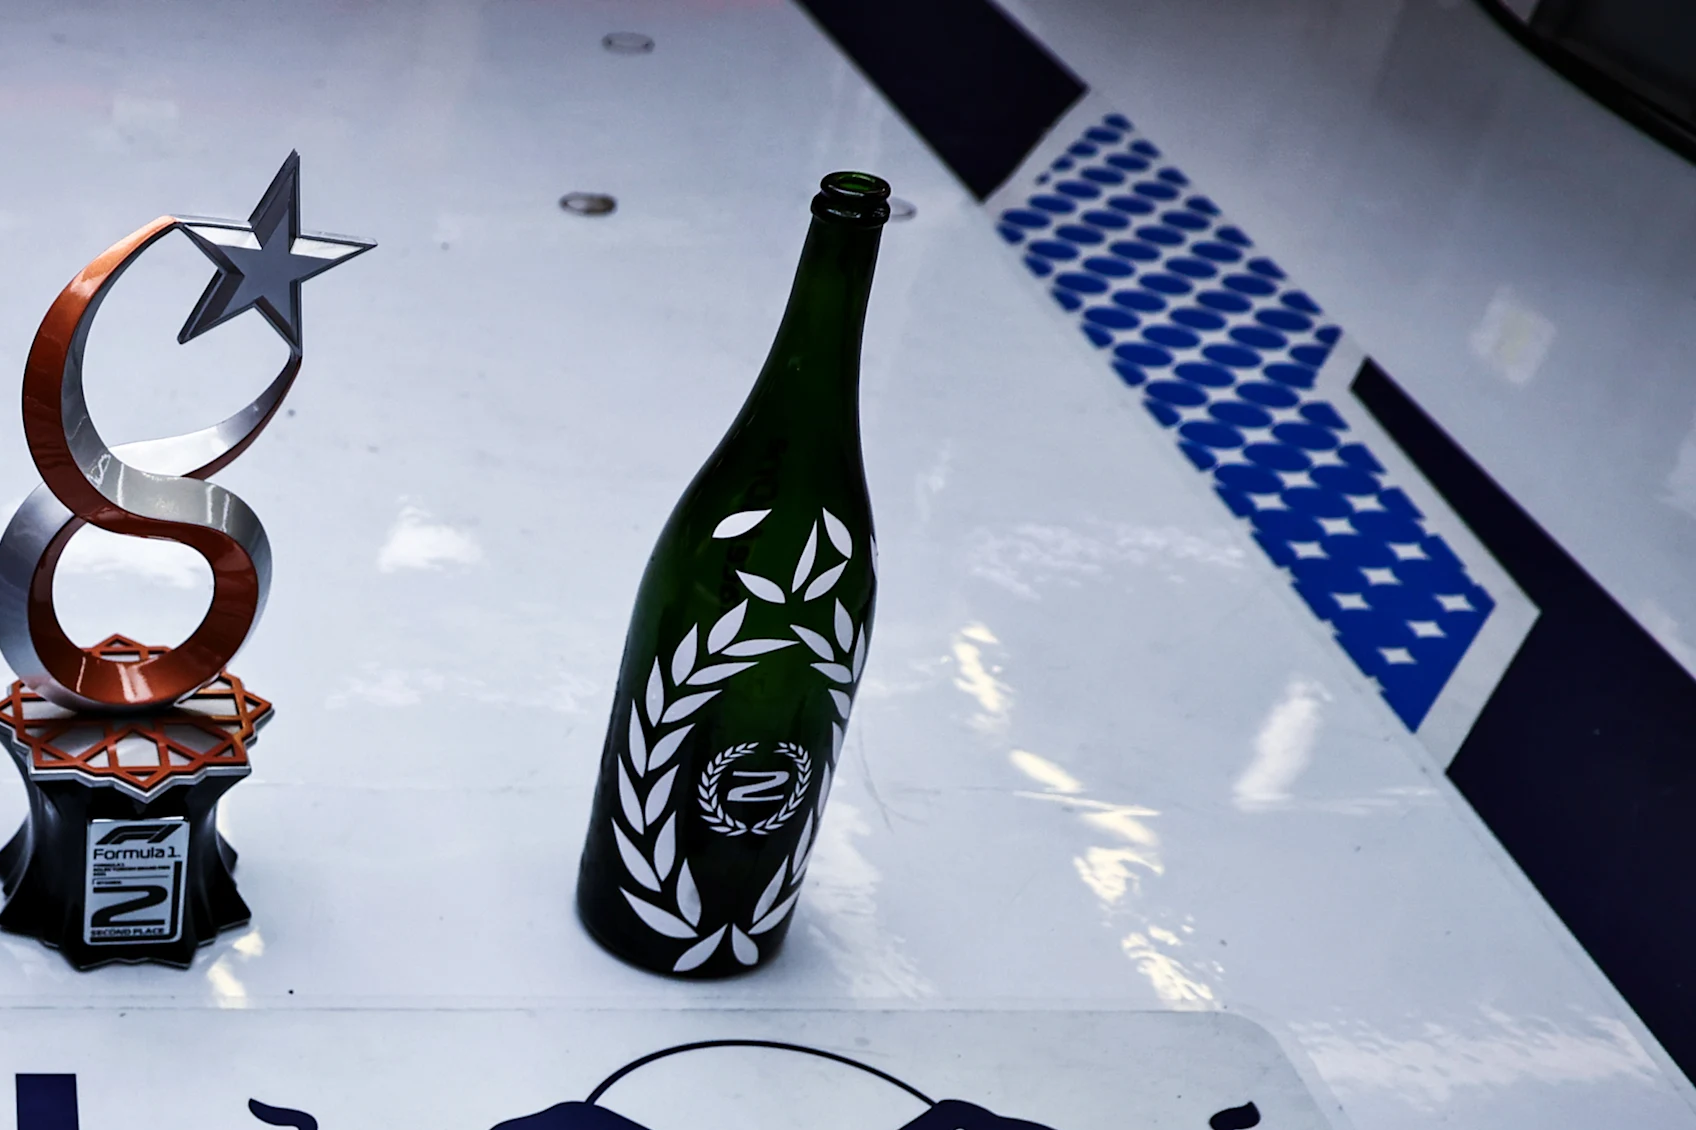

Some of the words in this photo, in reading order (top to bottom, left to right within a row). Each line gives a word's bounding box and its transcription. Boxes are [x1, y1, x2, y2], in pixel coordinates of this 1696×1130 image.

[727, 771, 790, 802] 2
[95, 823, 183, 845] F1
[93, 847, 165, 860] Formula
[90, 885, 169, 928] 2
[90, 928, 131, 937] SECOND
[133, 927, 165, 936] PLACE
